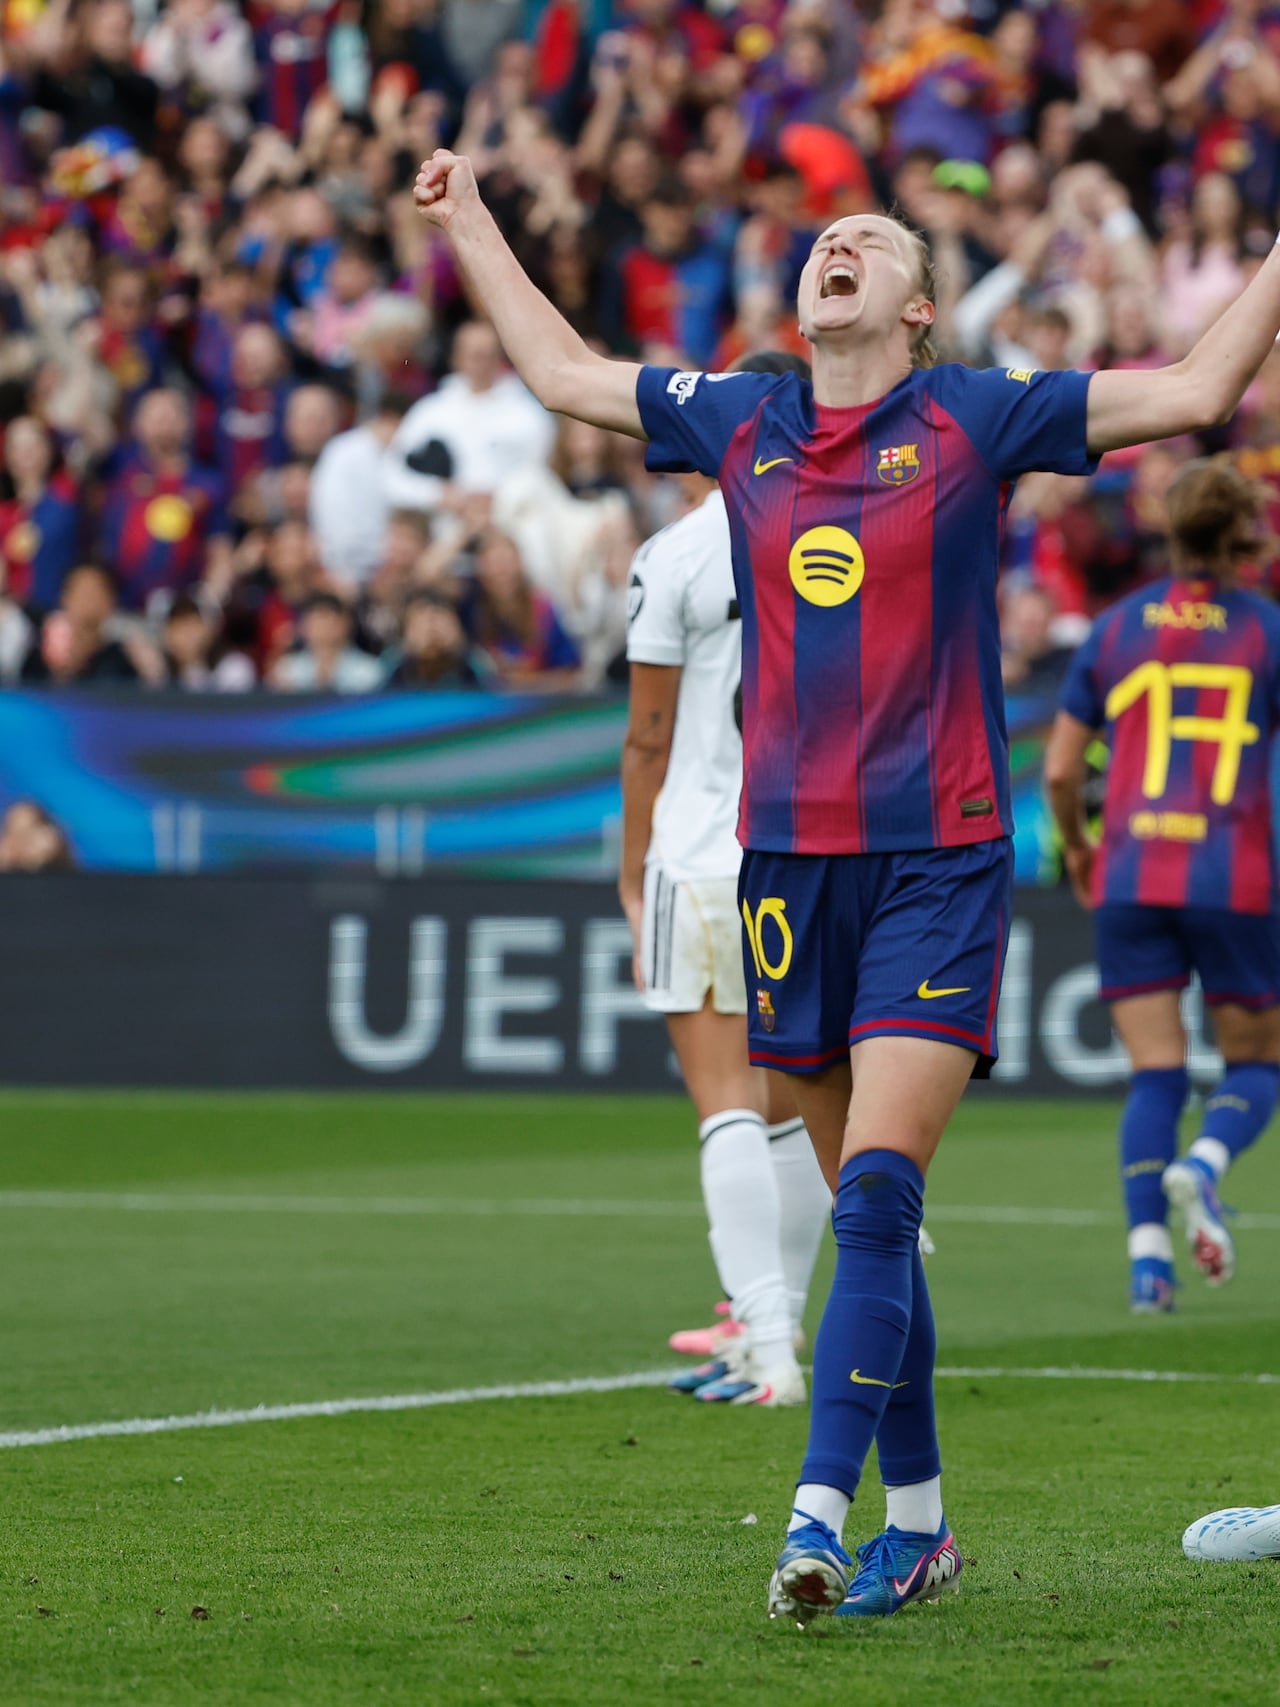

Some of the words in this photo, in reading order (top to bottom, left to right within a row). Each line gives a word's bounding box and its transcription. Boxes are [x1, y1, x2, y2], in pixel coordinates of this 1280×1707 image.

[1105, 660, 1260, 806] 17
[327, 913, 690, 1075] UEF
[742, 896, 794, 980] 10
